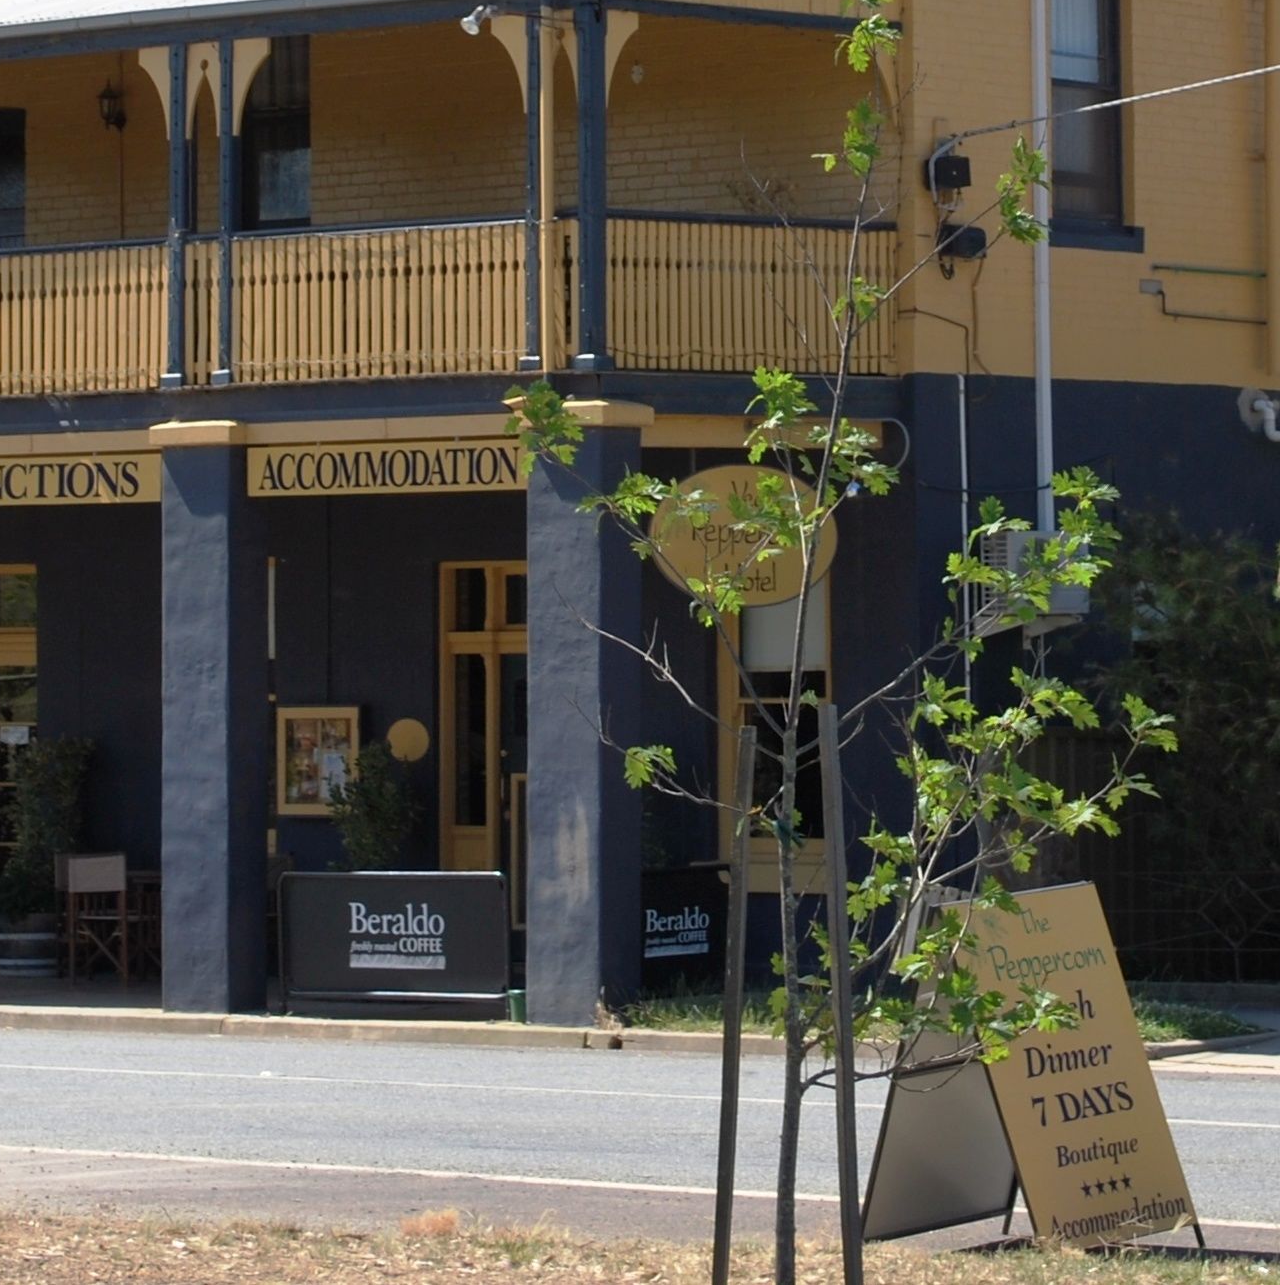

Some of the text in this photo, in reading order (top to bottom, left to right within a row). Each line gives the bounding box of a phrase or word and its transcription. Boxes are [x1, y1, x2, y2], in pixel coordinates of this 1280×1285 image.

[258, 446, 519, 490] ACCOMMODATION
[723, 561, 777, 592] otel
[348, 902, 445, 935] Beraldo
[645, 906, 709, 932] Beraldo
[1020, 908, 1051, 934] The
[399, 937, 443, 953] COFFEE
[987, 945, 1107, 987] Peppercorn
[1024, 1043, 1112, 1078] Dinner
[1031, 1081, 1134, 1127] 7 DAYS
[1056, 1137, 1138, 1168] Boutique
[1051, 1192, 1188, 1240] Accommodation
